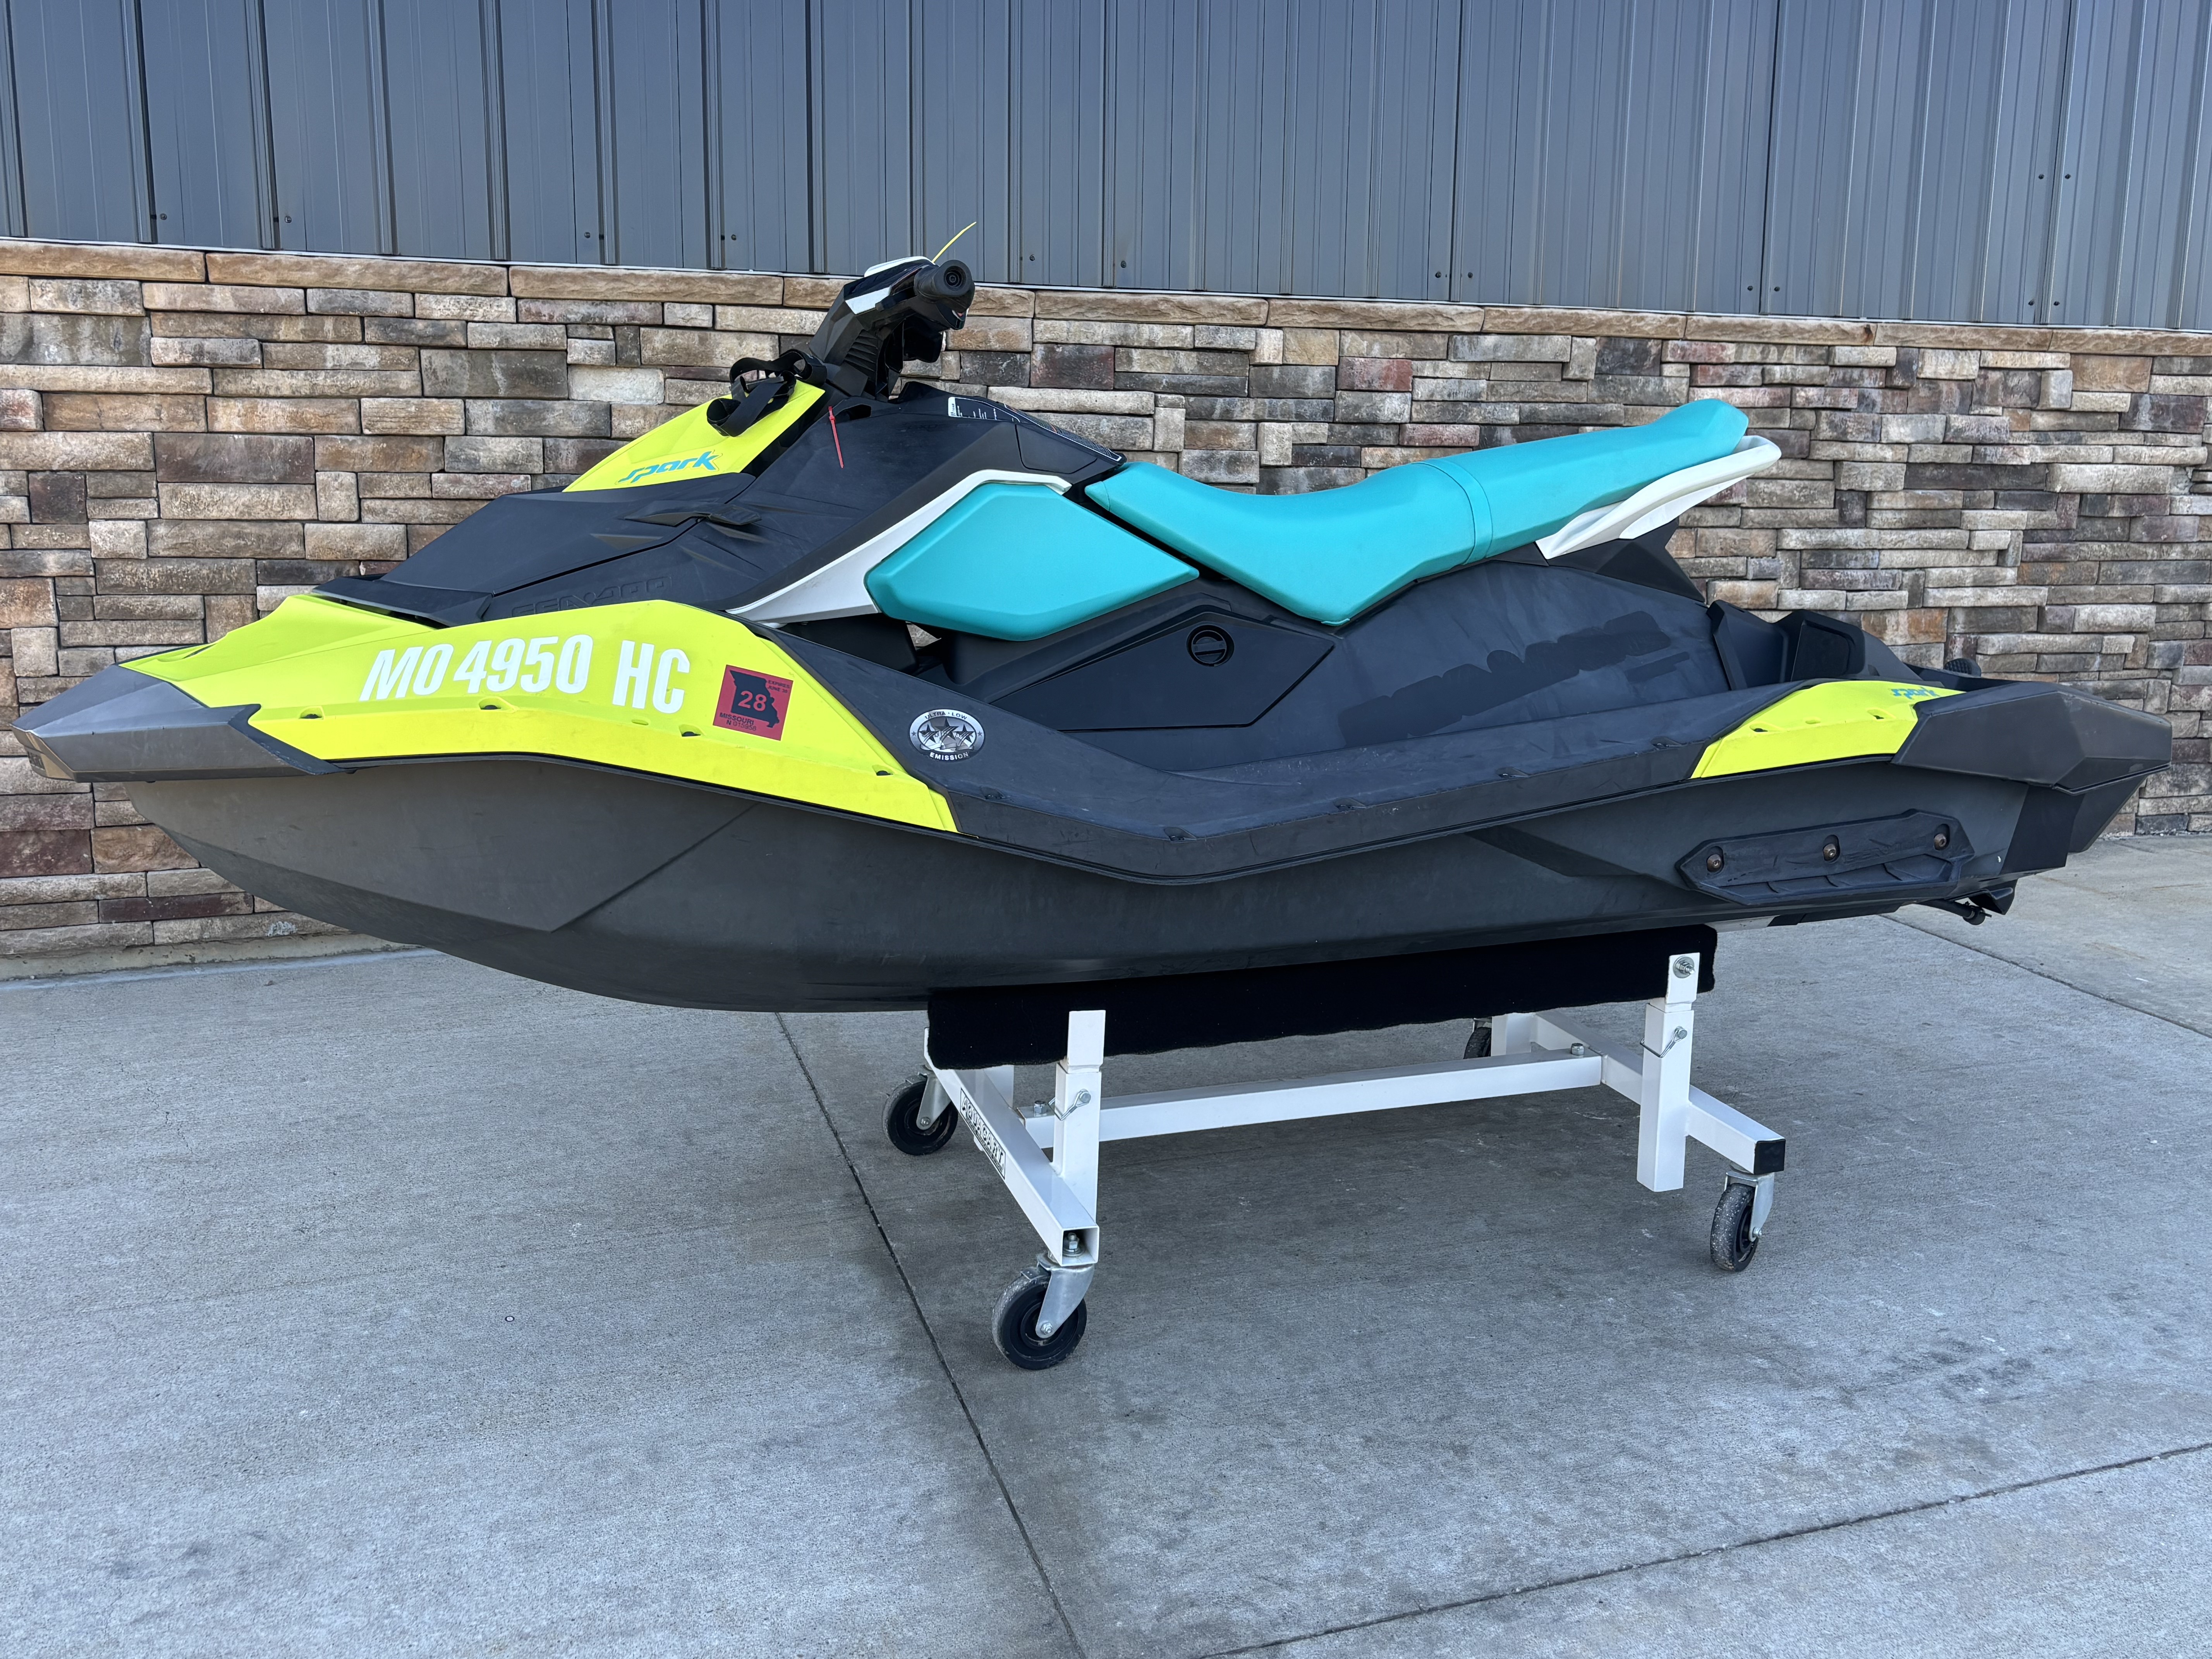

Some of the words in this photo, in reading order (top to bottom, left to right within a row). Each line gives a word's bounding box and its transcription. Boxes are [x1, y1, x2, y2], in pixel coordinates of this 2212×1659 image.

[617, 451, 719, 483] spark
[359, 643, 454, 701] MO
[453, 634, 593, 694] 4950
[612, 640, 690, 714] HC
[768, 680, 790, 689] EXPIRES
[738, 690, 767, 711] 28
[720, 713, 754, 725] MISSOURI
[925, 711, 946, 720] ULTRA
[951, 712, 967, 720] LOW
[733, 721, 757, 731] 015958
[929, 751, 969, 761] EMISSION
